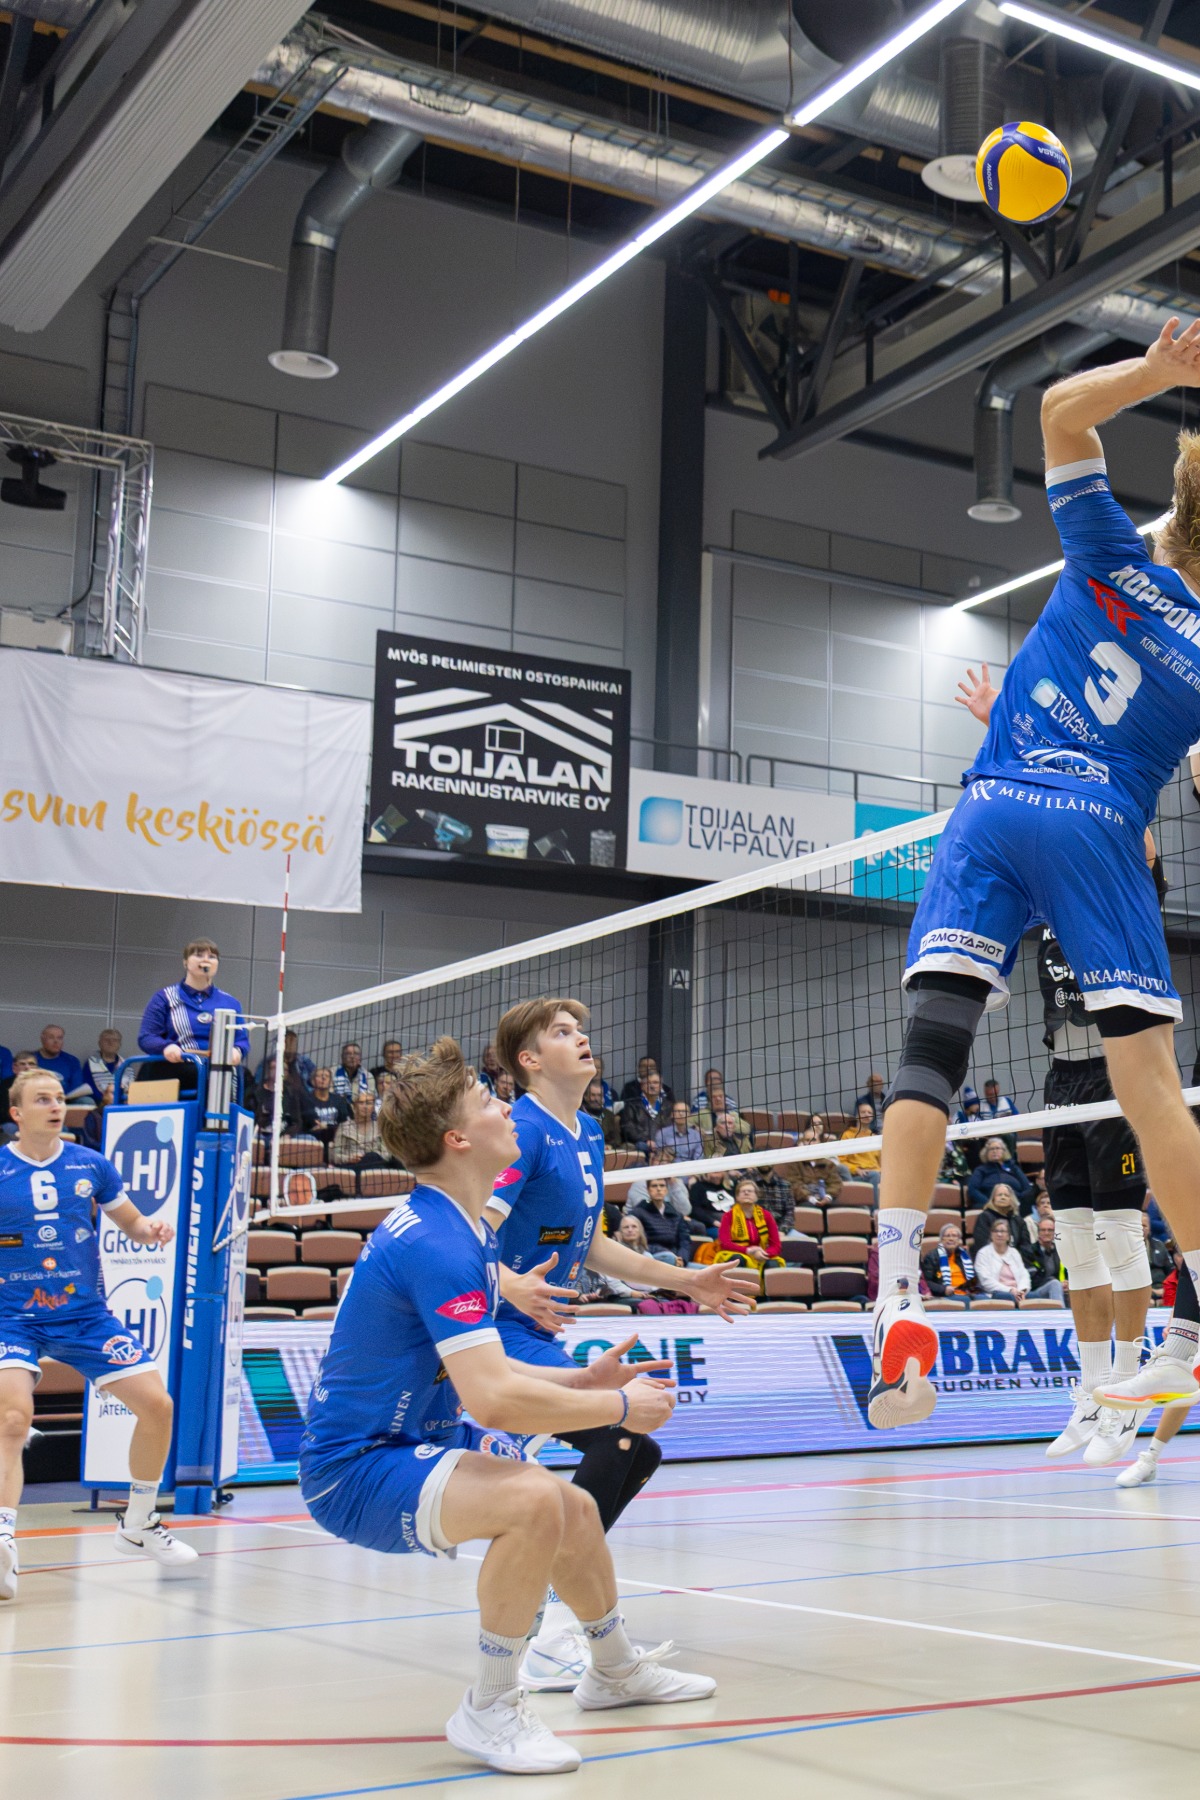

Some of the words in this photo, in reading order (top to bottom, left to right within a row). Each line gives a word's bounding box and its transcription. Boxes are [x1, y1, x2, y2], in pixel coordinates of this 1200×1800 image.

[387, 647, 428, 666] MYÖS
[432, 654, 522, 680] PELIMIESTEN
[525, 670, 623, 695] OSTOSPAIKKA!
[1139, 635, 1160, 658] KONE
[1159, 651, 1171, 667] JA
[1169, 646, 1193, 668] TOIJALAN
[1084, 641, 1143, 725] 3
[393, 739, 612, 793] TOIJALAN
[391, 770, 581, 809] RAKENNUSTARVIKE
[584, 795, 611, 812] OY
[998, 785, 1124, 826] MEHILÄINEN
[126, 792, 335, 855] keskiössä
[685, 804, 795, 837] TOIJALAN
[113, 1148, 169, 1200] LHJ
[577, 1151, 599, 1208] 5
[1121, 1153, 1136, 1175] 21
[30, 1169, 59, 1212] 6
[108, 1307, 158, 1356] HJ
